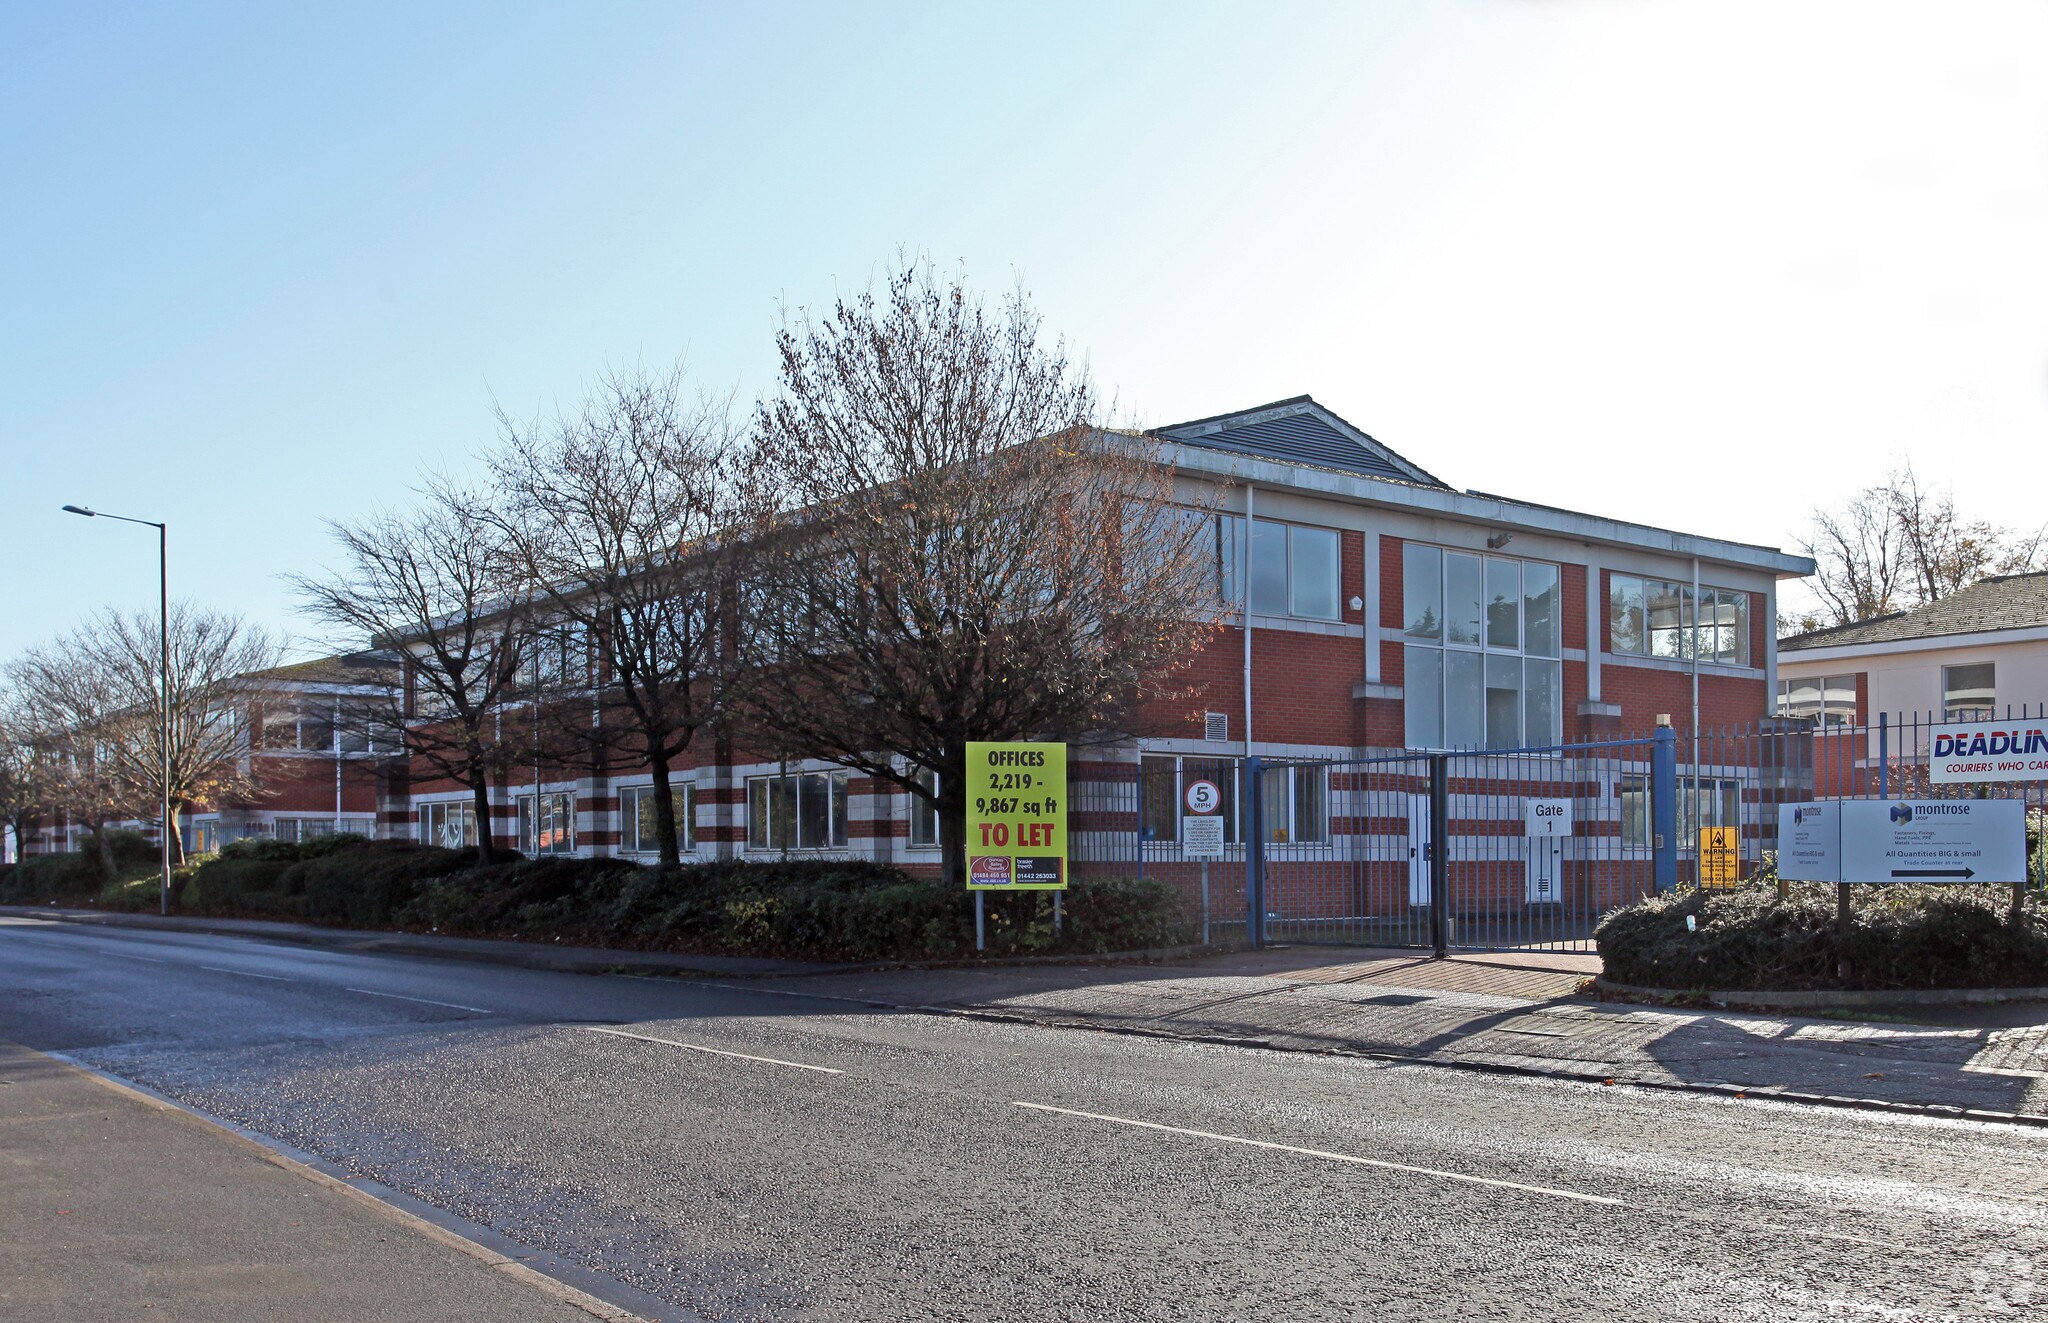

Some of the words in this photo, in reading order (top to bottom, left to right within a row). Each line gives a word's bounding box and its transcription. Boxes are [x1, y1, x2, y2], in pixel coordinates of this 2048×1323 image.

[1934, 730, 2048, 757] DEADLIN
[988, 751, 1044, 766] OFFICES
[1946, 762, 1993, 773] COURIERS
[1998, 761, 2024, 771] WHO
[990, 774, 1032, 792] 2,219
[1196, 787, 1209, 802] 5
[976, 798, 1018, 816] 9,867
[1023, 802, 1040, 816] sq
[1045, 797, 1057, 814] ft
[1536, 805, 1563, 816] Gate
[1915, 804, 1970, 814] montrose
[1547, 821, 1552, 832] 1
[979, 823, 1009, 846] TO
[1018, 823, 1054, 846] LET
